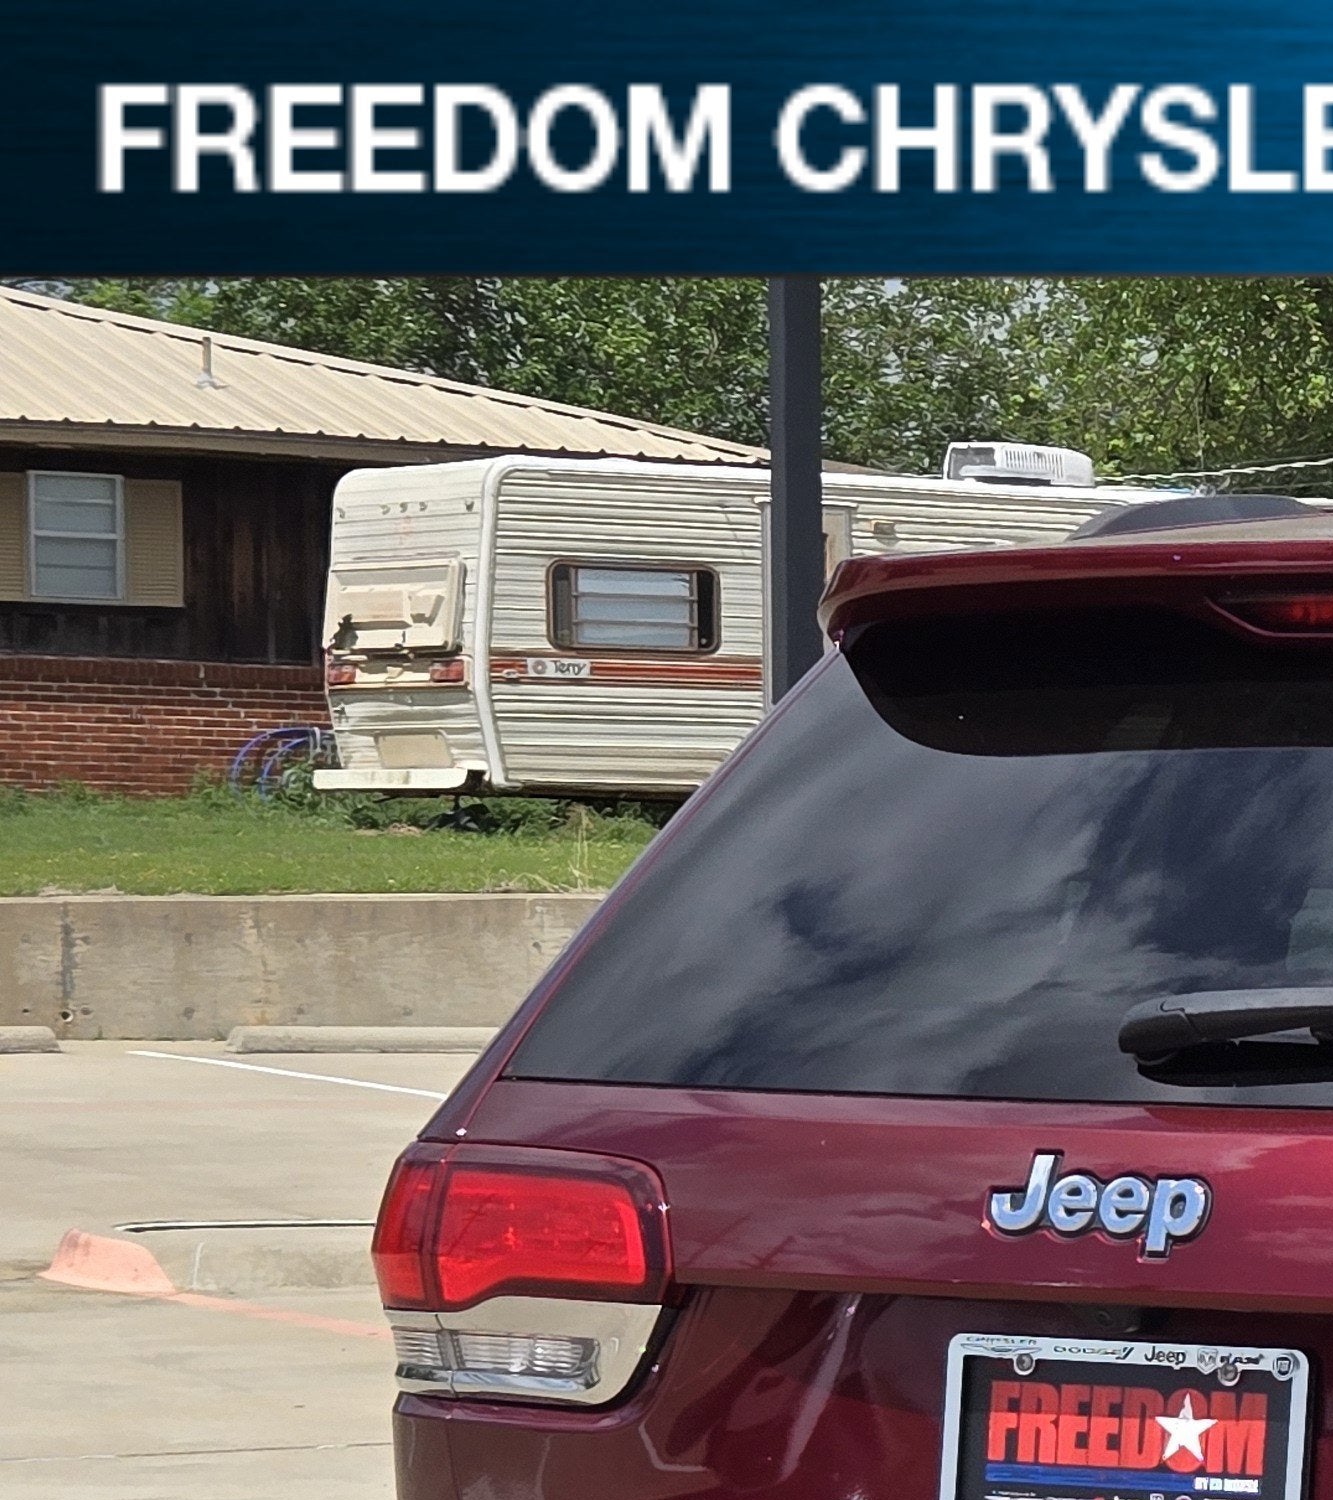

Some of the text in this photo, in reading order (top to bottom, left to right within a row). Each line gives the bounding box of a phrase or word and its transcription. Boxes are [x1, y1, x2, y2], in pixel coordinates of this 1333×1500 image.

[987, 1150, 1211, 1257] Jeep
[1143, 1345, 1187, 1366] Jeep
[986, 1380, 1269, 1477] FREEDOM
